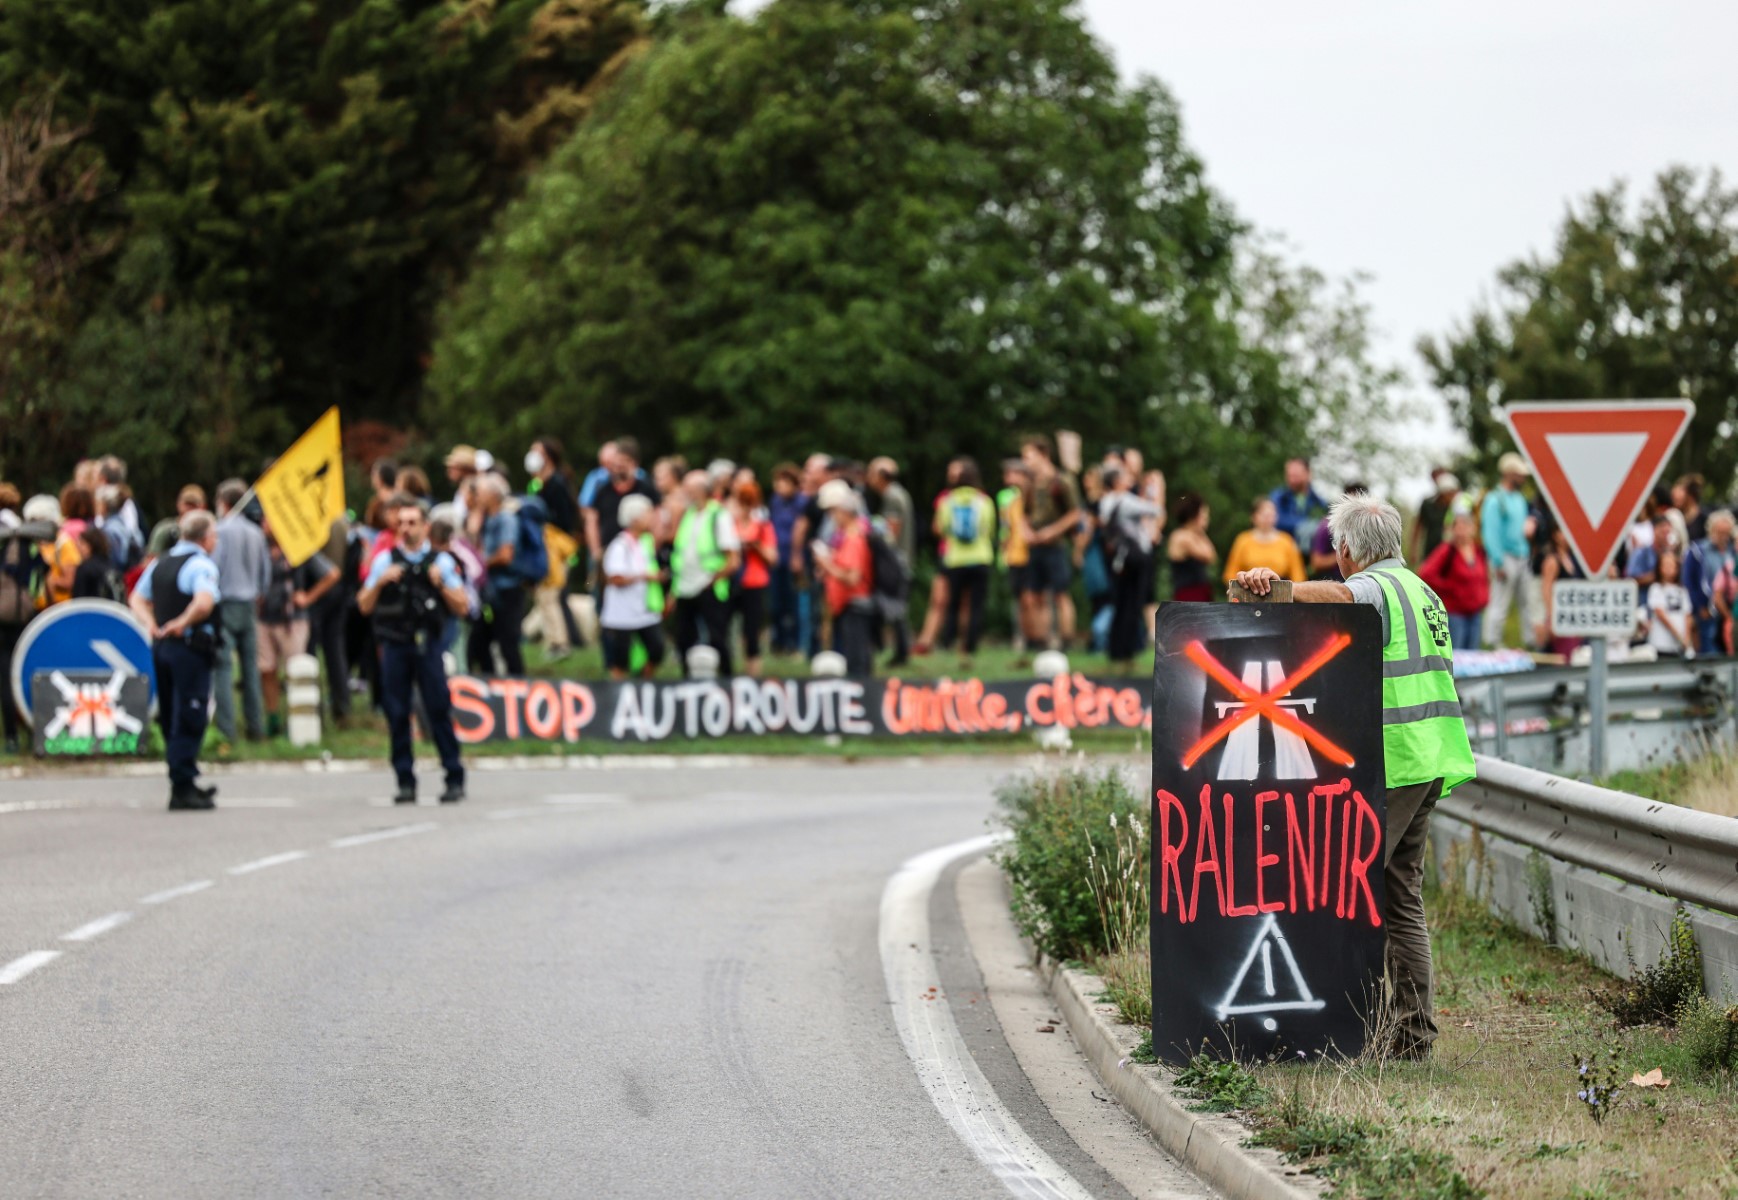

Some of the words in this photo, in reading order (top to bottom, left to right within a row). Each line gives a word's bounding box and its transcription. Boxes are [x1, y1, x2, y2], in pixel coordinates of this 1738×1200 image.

[1557, 587, 1608, 606] CÉDEZ
[1612, 590, 1631, 606] LE
[1557, 611, 1631, 627] PASSAGE
[448, 675, 596, 743] STOP
[611, 676, 874, 741] AUTOROUTE
[1157, 778, 1382, 927] RALENTIR
